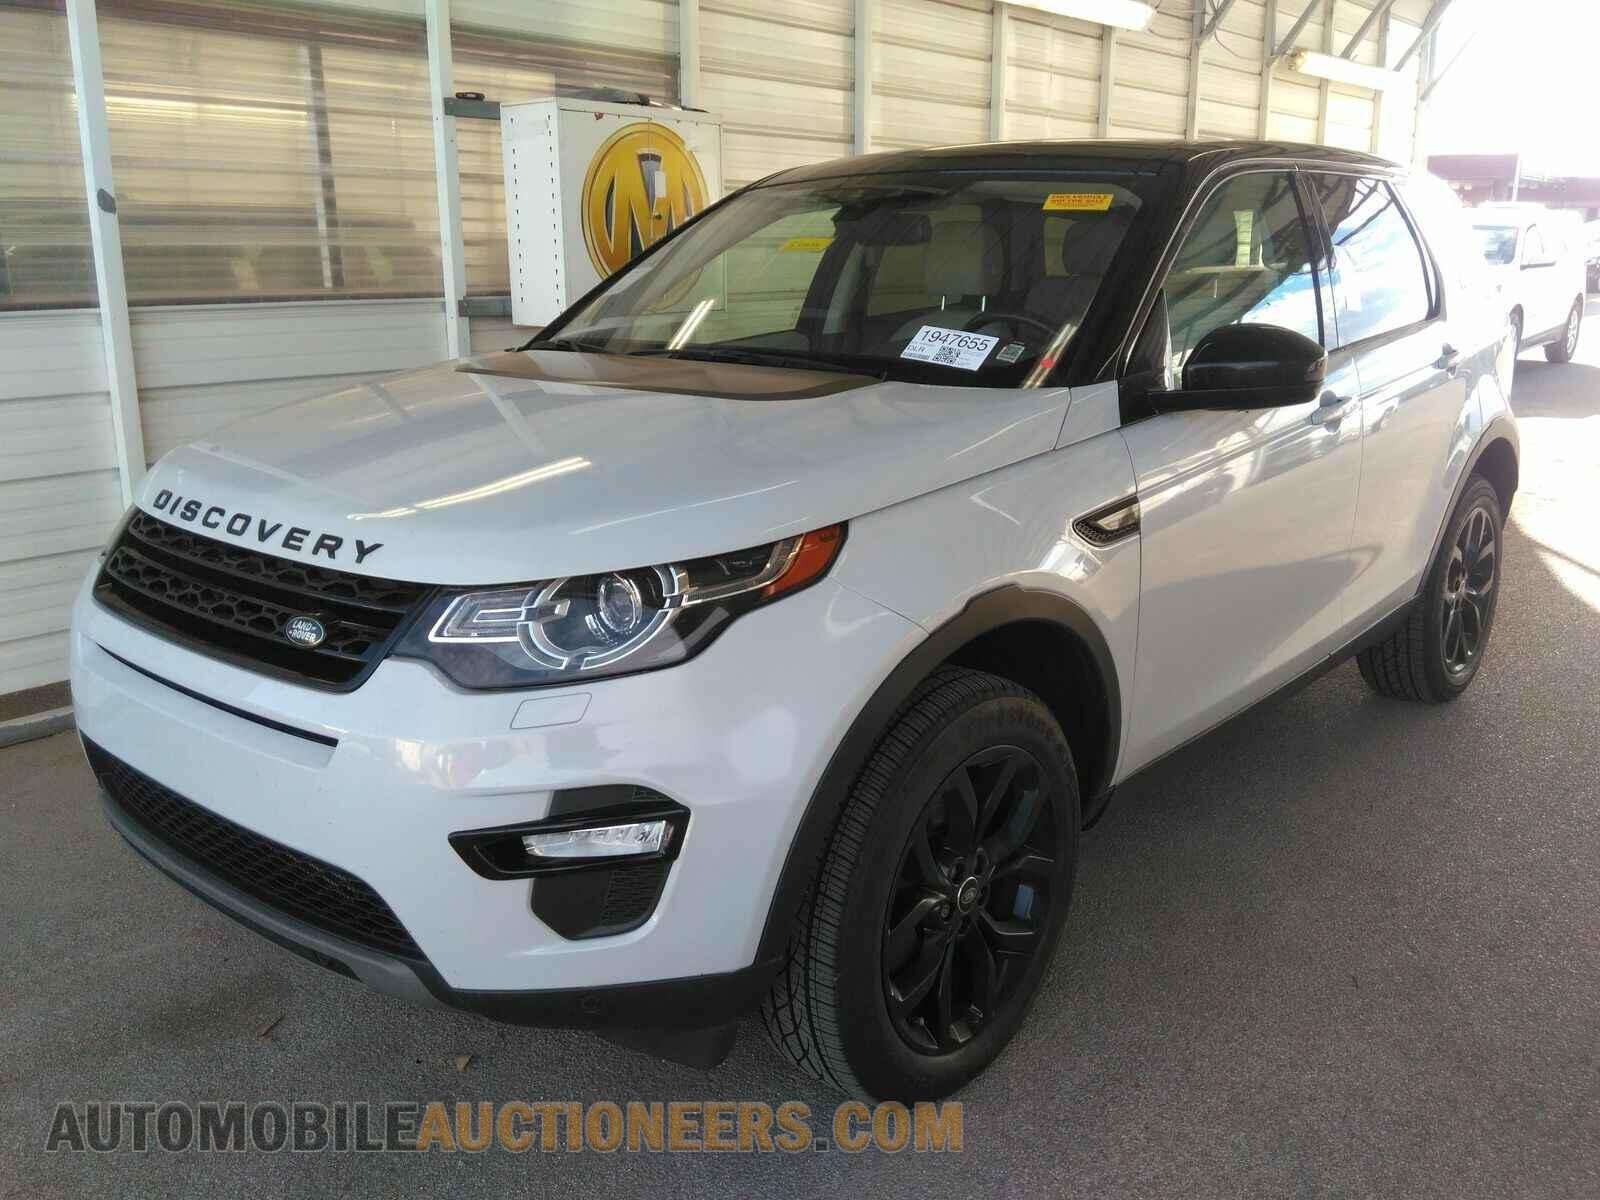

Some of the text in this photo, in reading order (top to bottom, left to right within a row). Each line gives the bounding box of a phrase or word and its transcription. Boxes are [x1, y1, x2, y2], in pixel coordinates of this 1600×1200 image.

[921, 329, 991, 352] 1947655
[153, 489, 385, 564] DISCOVERY
[292, 620, 312, 631] LAND
[291, 629, 317, 642] ROVER
